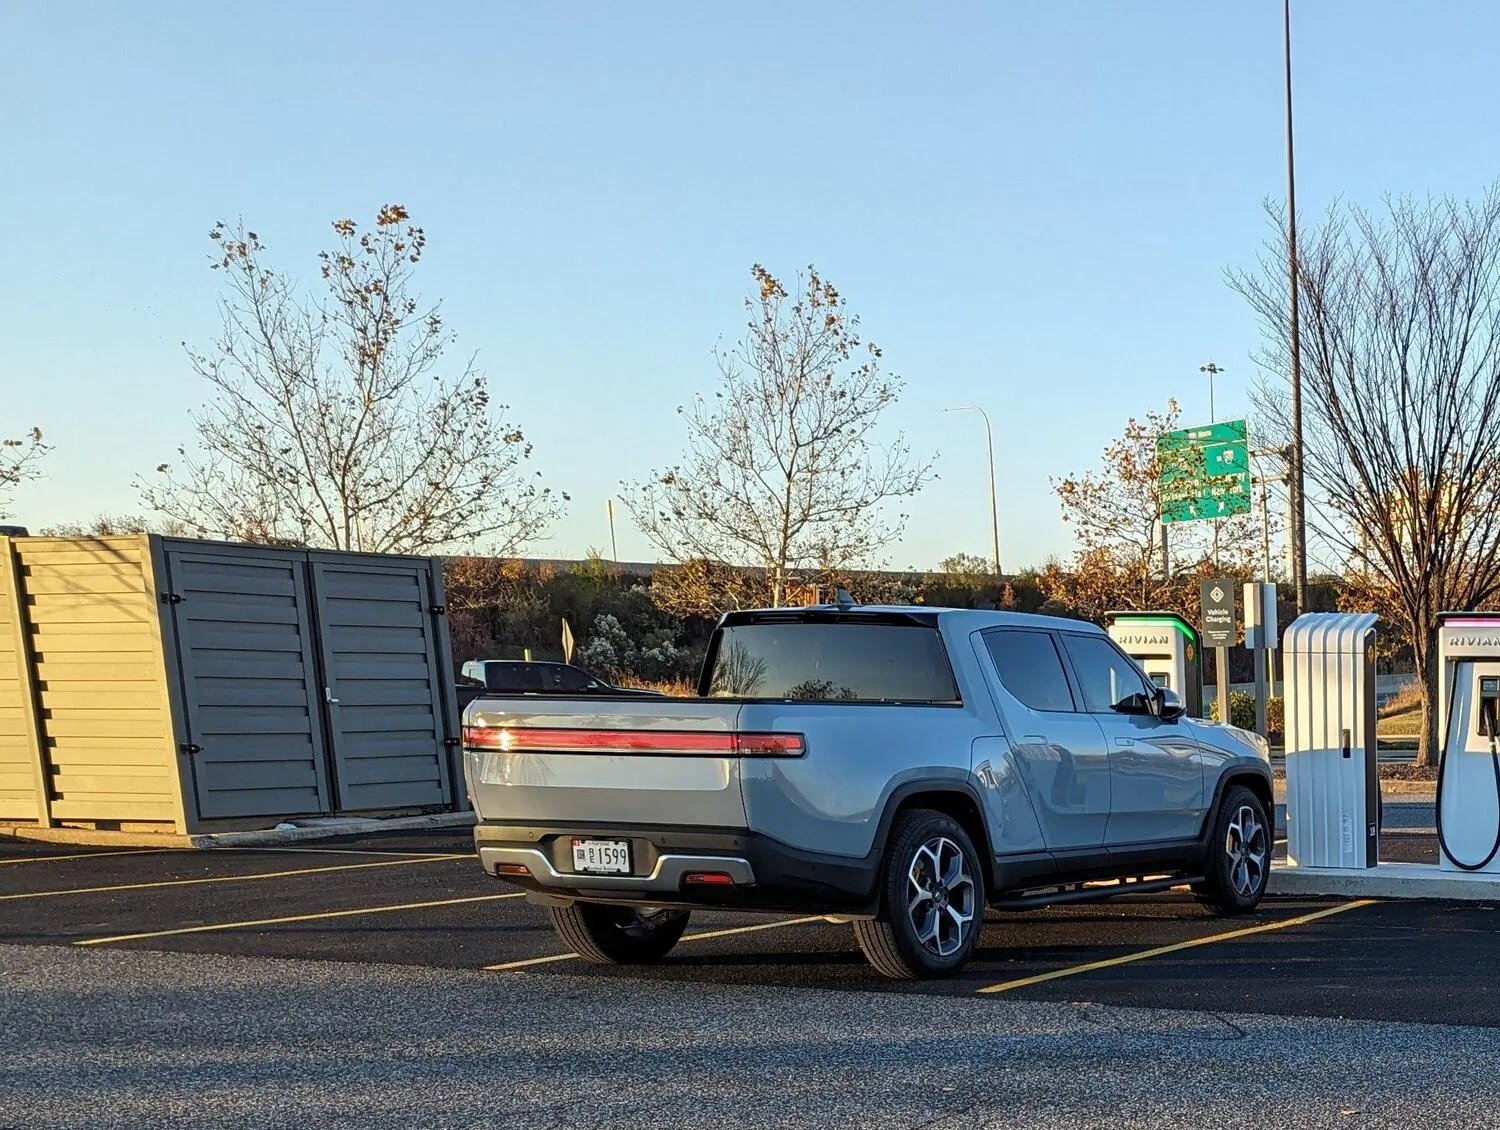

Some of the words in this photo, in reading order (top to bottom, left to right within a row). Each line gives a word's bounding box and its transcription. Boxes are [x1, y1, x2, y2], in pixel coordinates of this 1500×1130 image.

[1205, 616, 1232, 624] Charging
[1119, 635, 1169, 644] RIVIAN
[598, 847, 627, 866] 1599
